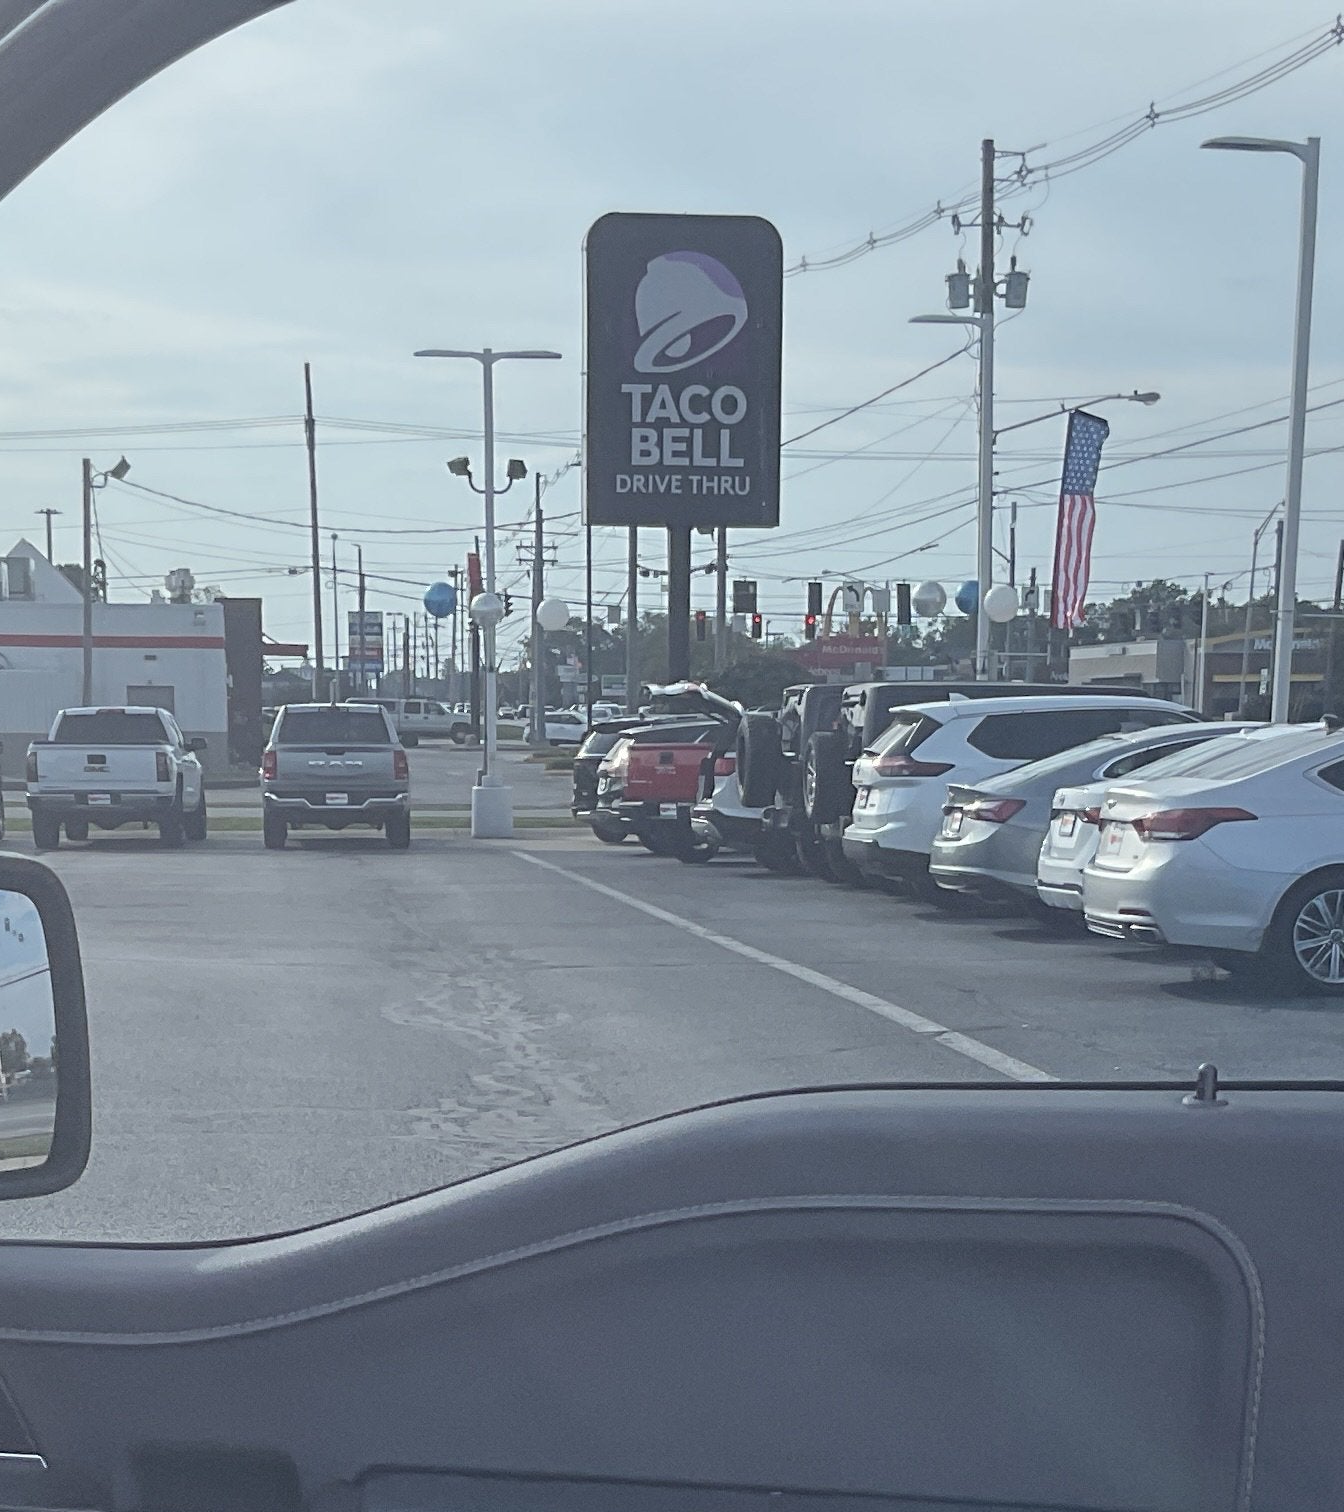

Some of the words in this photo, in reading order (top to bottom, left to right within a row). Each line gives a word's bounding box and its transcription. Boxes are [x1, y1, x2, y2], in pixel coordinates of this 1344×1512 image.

[621, 383, 747, 424] TACO
[631, 428, 744, 467] BELL
[615, 474, 682, 494] DRIVE
[689, 475, 750, 495] THRU
